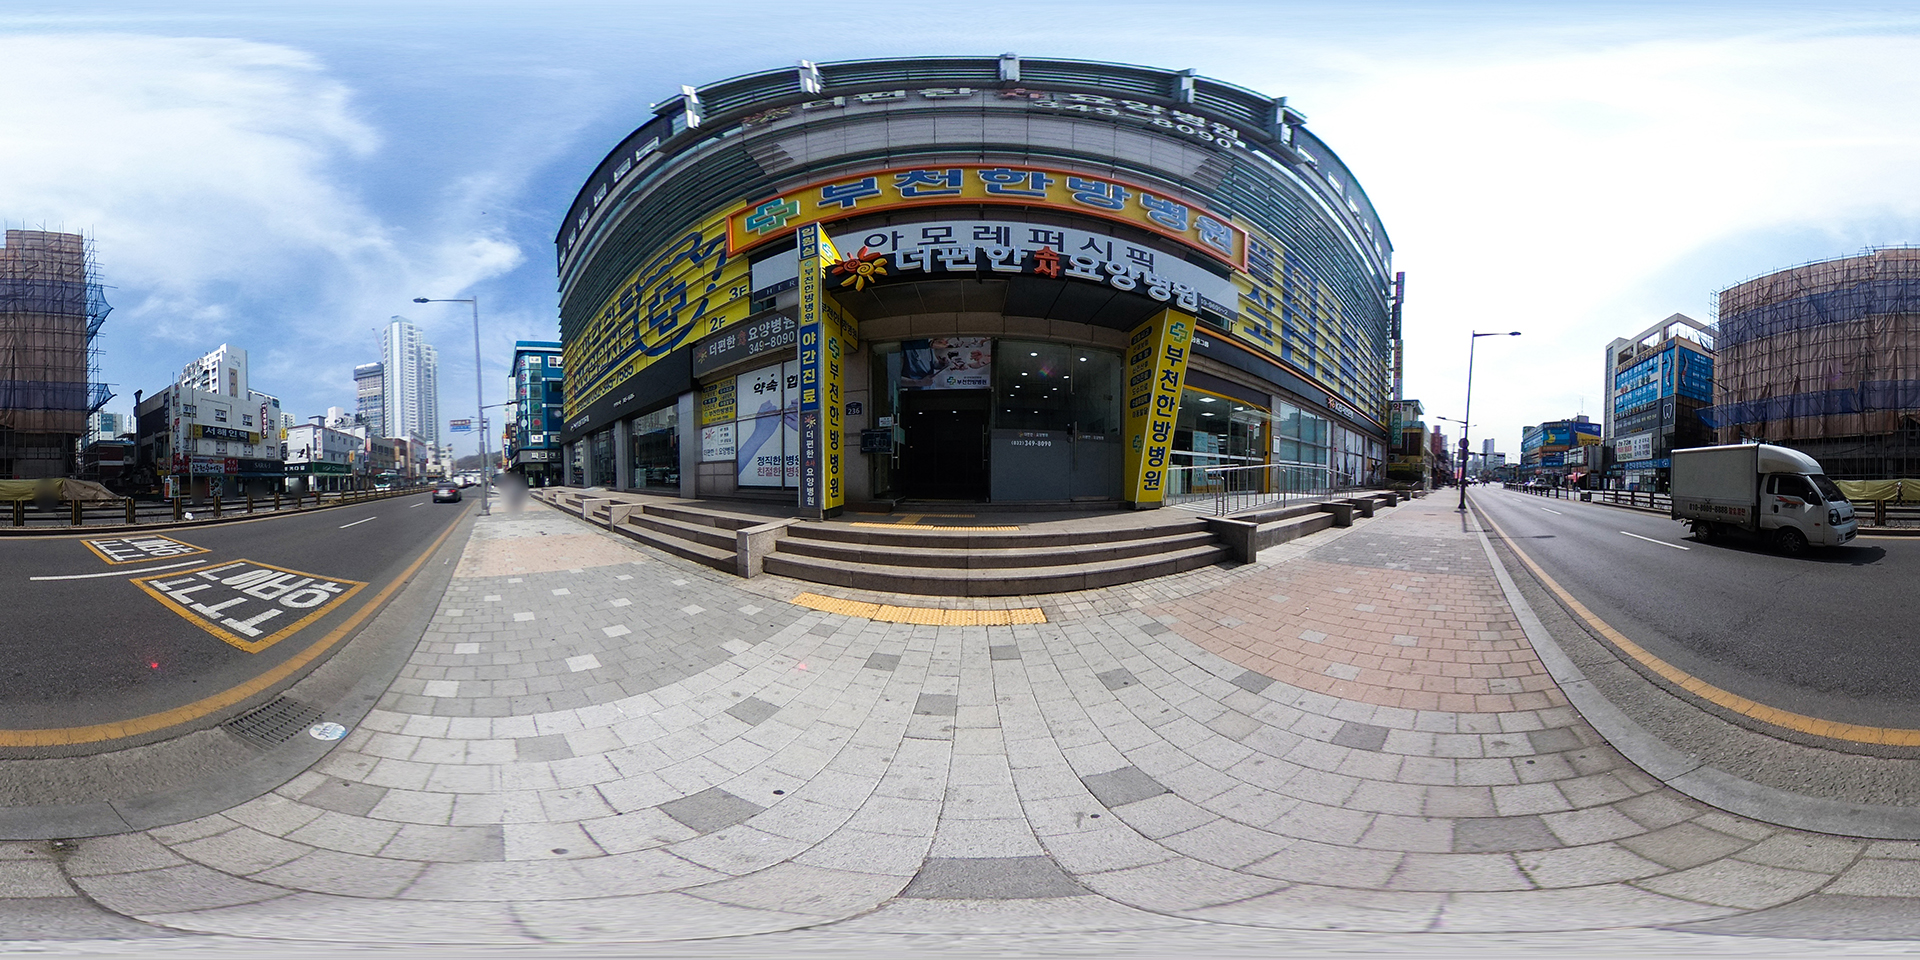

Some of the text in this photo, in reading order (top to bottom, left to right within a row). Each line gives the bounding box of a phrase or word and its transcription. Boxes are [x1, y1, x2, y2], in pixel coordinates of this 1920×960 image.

[1034, 101, 1233, 149] 349-8090
[817, 168, 1234, 258] 부천한방병원
[864, 225, 1156, 273] 아모레퍼시픽
[728, 285, 747, 301] 3F
[896, 244, 1027, 274] 더편한
[1065, 252, 1200, 313] 요양병원
[709, 316, 726, 332] 2F
[709, 335, 736, 356] 더편한
[748, 317, 795, 341] 요양병원
[749, 331, 795, 355] 349-8090
[753, 373, 778, 394] 약속
[803, 332, 816, 404] 야간진료
[847, 407, 861, 415] 236
[1144, 344, 1184, 491] 부천한방병원
[205, 427, 248, 439] 서해인력
[829, 361, 840, 498] 부천한방병원
[757, 455, 781, 466] 정직한
[757, 466, 781, 477] 친절한
